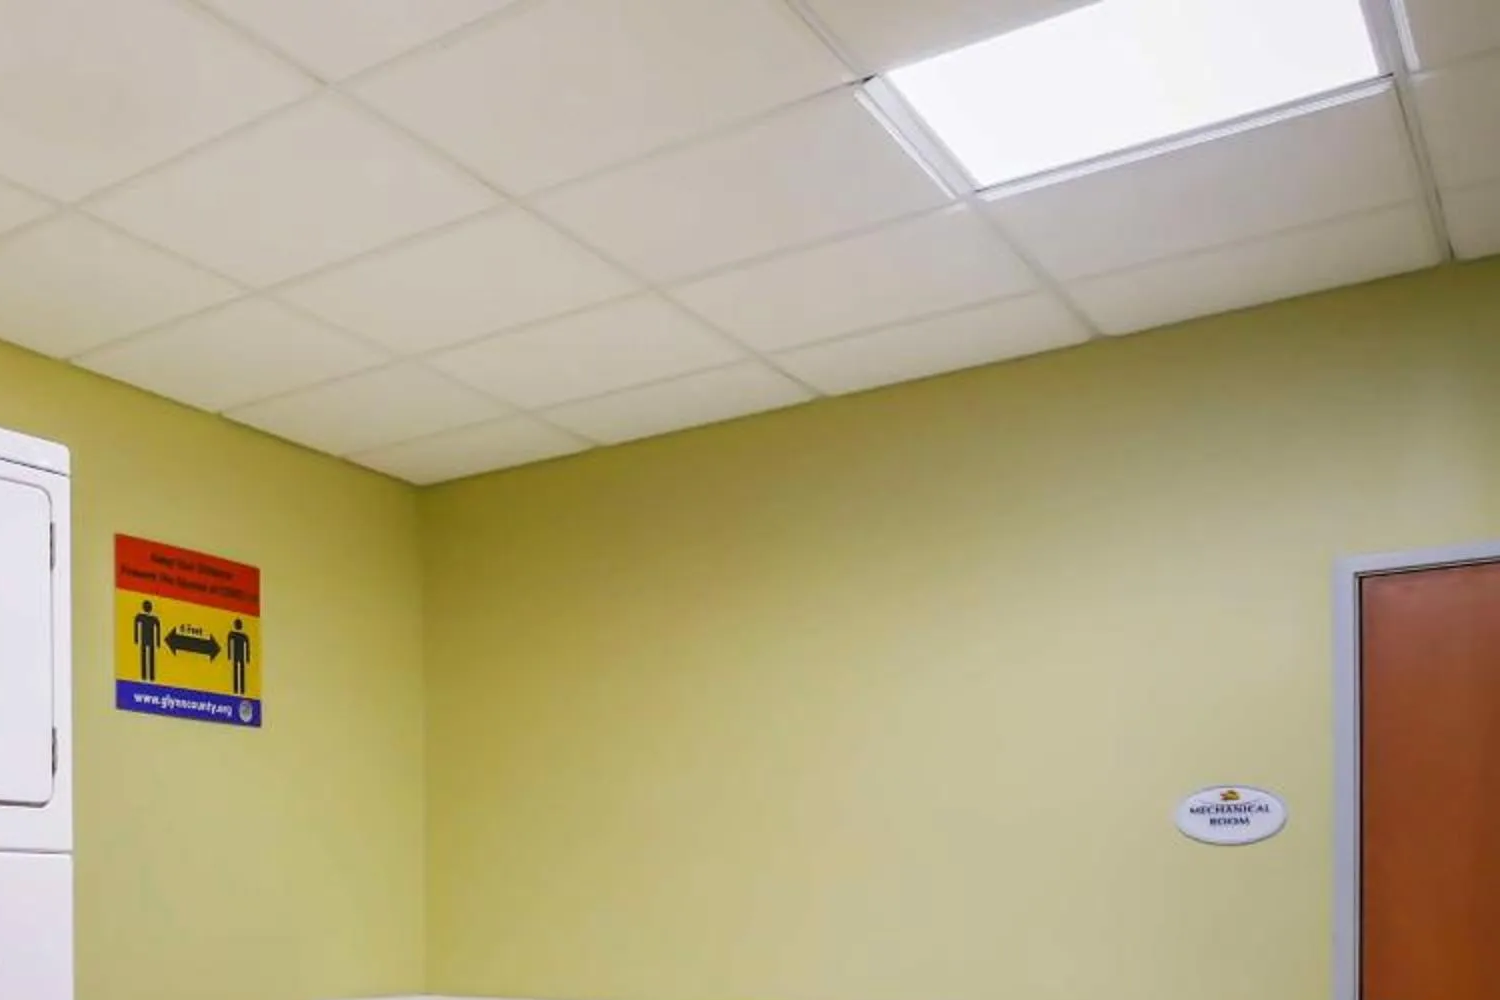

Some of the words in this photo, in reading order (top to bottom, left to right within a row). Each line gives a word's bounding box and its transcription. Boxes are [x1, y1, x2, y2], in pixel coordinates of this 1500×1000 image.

[133, 693, 233, 717] www.glynncounty.org
[1189, 803, 1270, 815] MECHANICAL
[1209, 817, 1251, 826] ROOM
